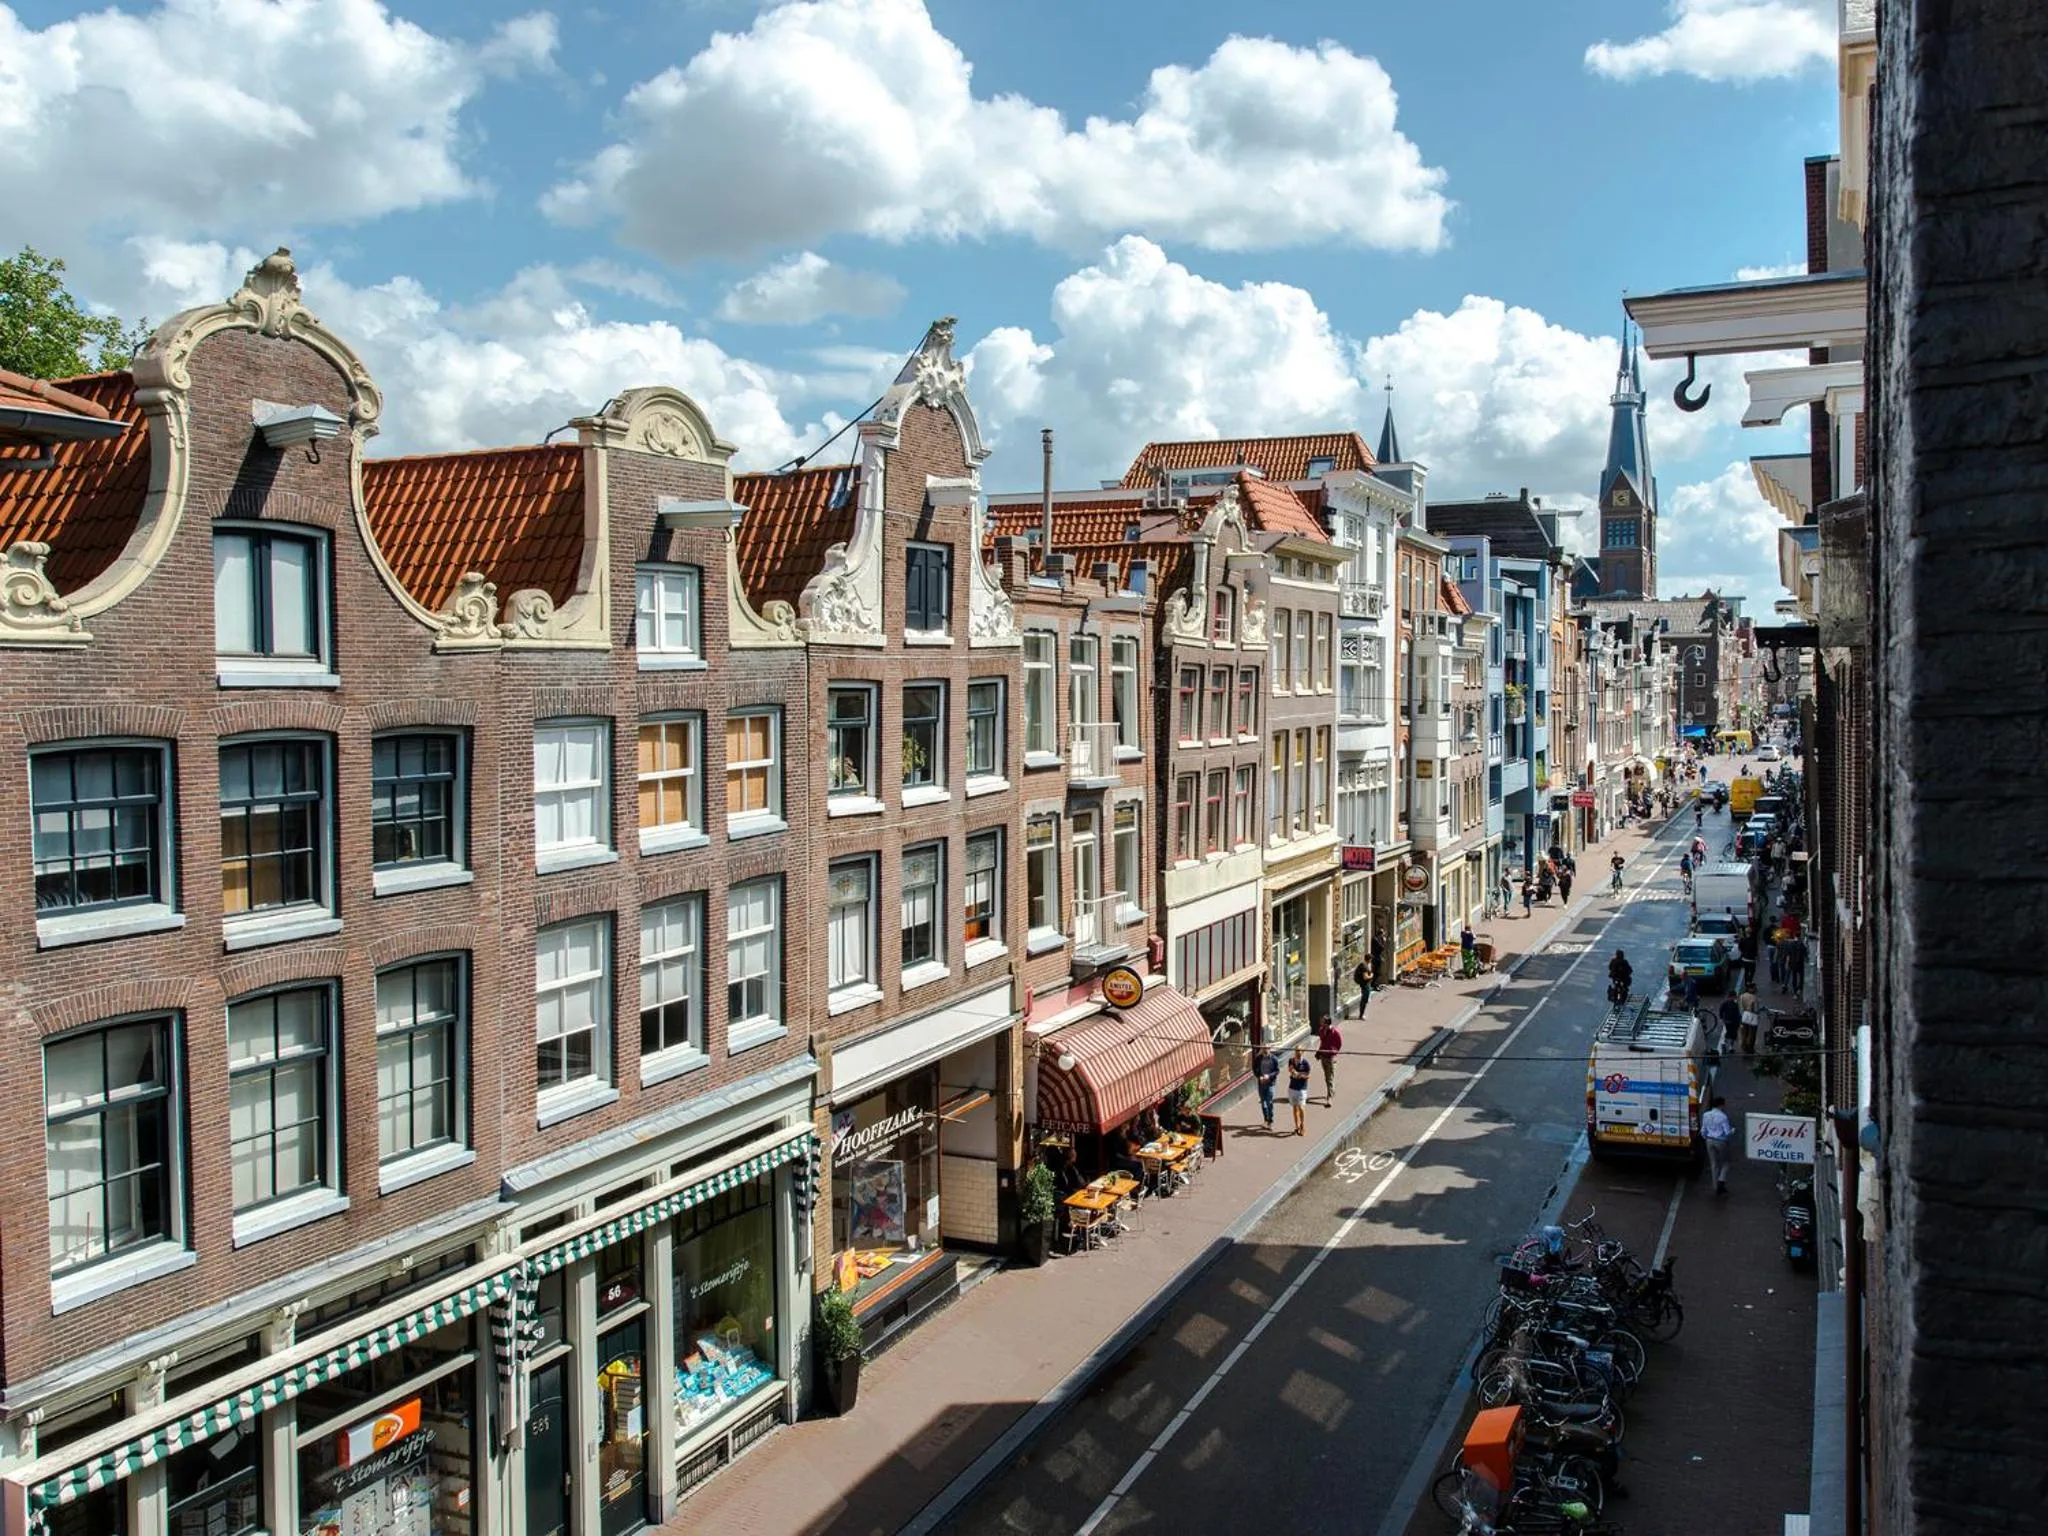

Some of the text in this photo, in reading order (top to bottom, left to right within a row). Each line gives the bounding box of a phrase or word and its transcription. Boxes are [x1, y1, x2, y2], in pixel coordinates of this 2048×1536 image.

[840, 1105, 917, 1157] HOOFFZAAK
[1752, 1120, 1808, 1141] Jonk
[1758, 1149, 1804, 1160] POELIER
[608, 1284, 622, 1301] 56
